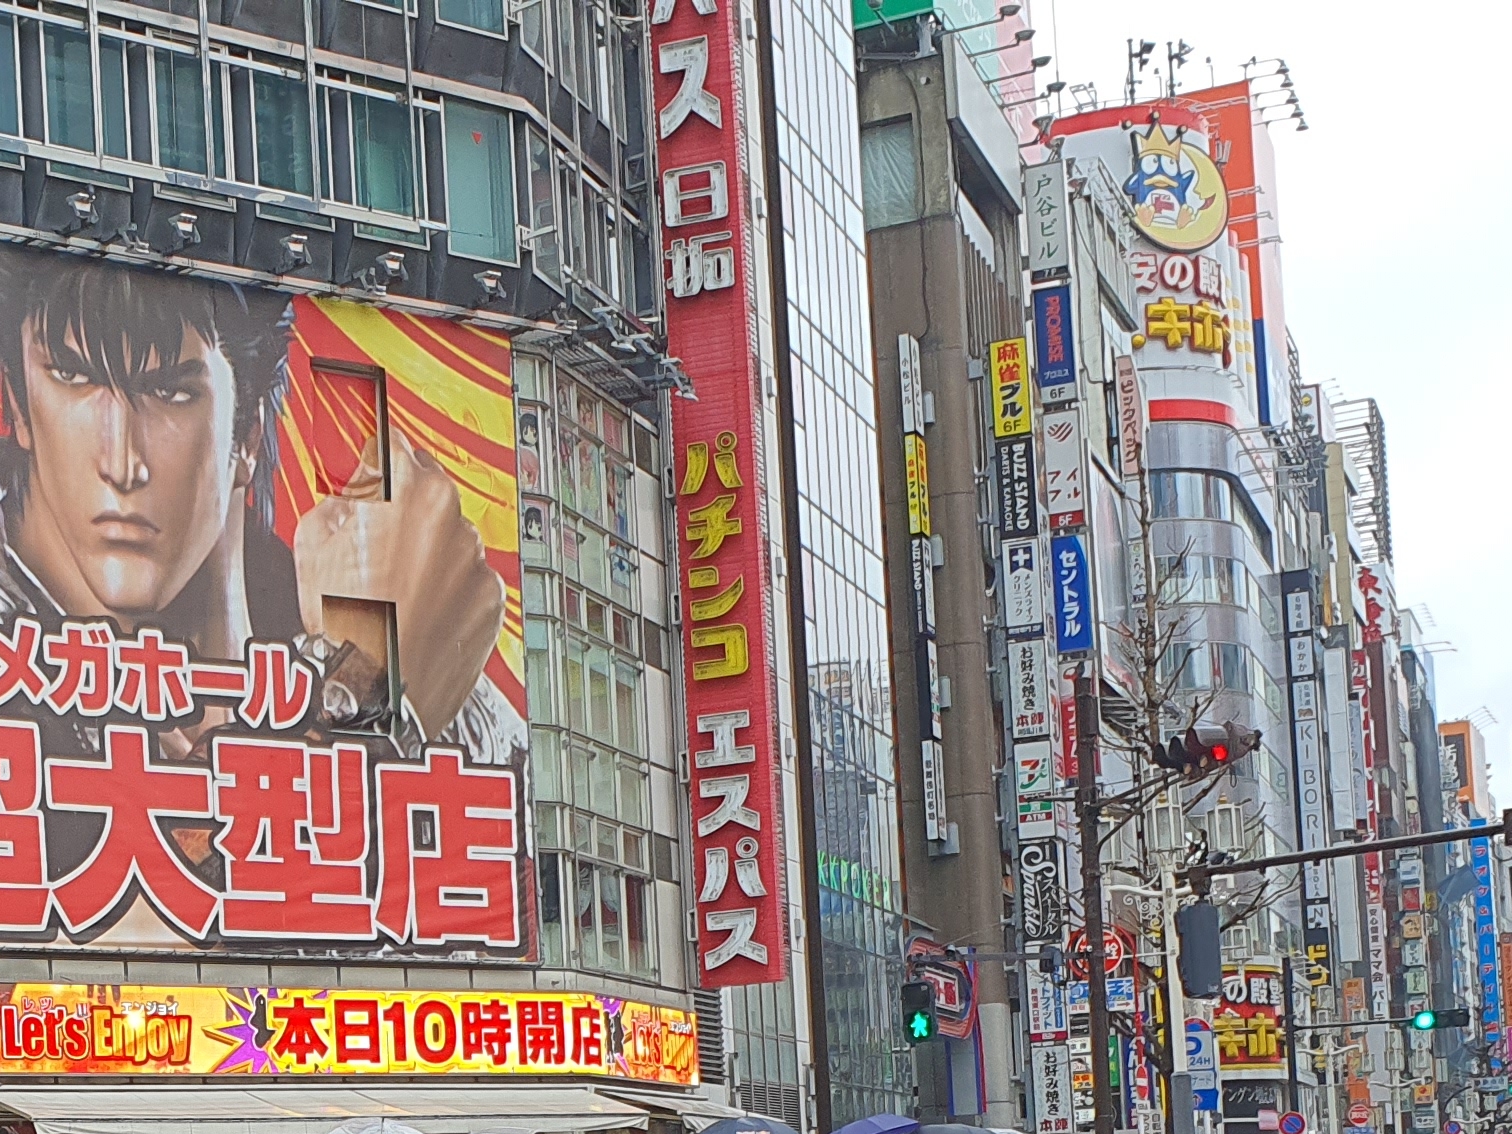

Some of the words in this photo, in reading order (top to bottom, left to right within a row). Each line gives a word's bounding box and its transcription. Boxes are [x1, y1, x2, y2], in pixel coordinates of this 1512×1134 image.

[1033, 173, 1059, 261] 戸谷ビル
[1045, 295, 1064, 364] PROMISE
[996, 342, 1023, 418] 麻雀ブル
[1050, 387, 1065, 400] 6F
[1002, 419, 1022, 433] 6F
[1011, 442, 1028, 481] BUZZ
[1014, 483, 1030, 531] STAND
[1058, 515, 1073, 528] 5F
[679, 431, 749, 682] パチンコ
[1058, 549, 1082, 638] セントラル
[1020, 646, 1036, 711] お好み焼き
[695, 708, 769, 972] エスパス
[1025, 813, 1046, 822] ATM
[1020, 845, 1056, 939] Sparkle
[1370, 949, 1384, 983] ママ会
[120, 1001, 179, 1016] エンジョイ
[273, 997, 602, 1067] 本日10時開店
[1040, 975, 1052, 1031] イトフィット
[1, 1005, 90, 1060] Let's
[90, 1007, 193, 1063] Enjoy
[1190, 1057, 1211, 1066] 24H
[1044, 1052, 1060, 1116] お好み焼き
